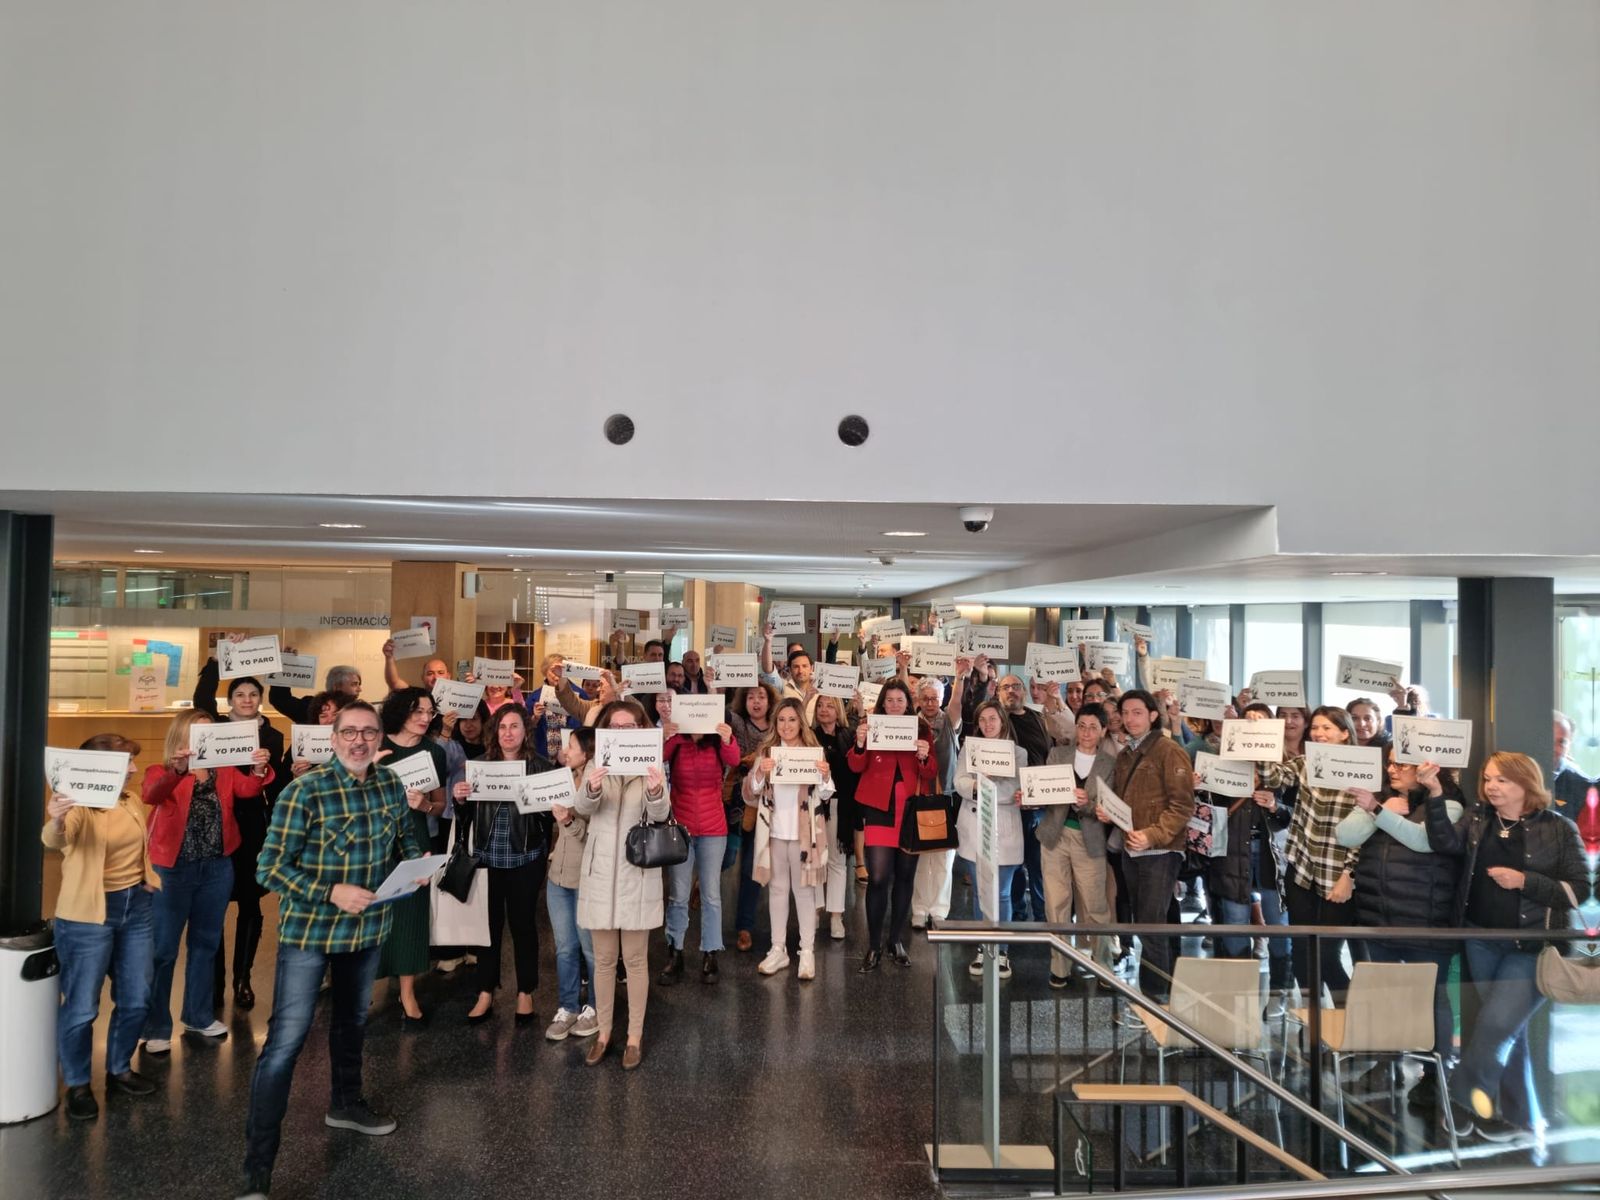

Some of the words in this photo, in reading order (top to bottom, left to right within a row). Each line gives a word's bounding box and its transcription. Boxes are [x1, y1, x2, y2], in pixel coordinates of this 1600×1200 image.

[320, 615, 391, 626] INFORMACIÓ
[253, 656, 274, 664] PARO
[1371, 680, 1394, 688] PARO
[1418, 745, 1432, 753] YO
[1434, 746, 1462, 755] PARO
[1331, 770, 1344, 778] YO
[1346, 772, 1374, 780] PARO
[69, 782, 84, 790] YO
[87, 783, 114, 792] PARO
[410, 777, 431, 788] PARO
[1214, 777, 1225, 785] YO
[1226, 780, 1248, 788] PARO
[548, 791, 570, 801] PARO
